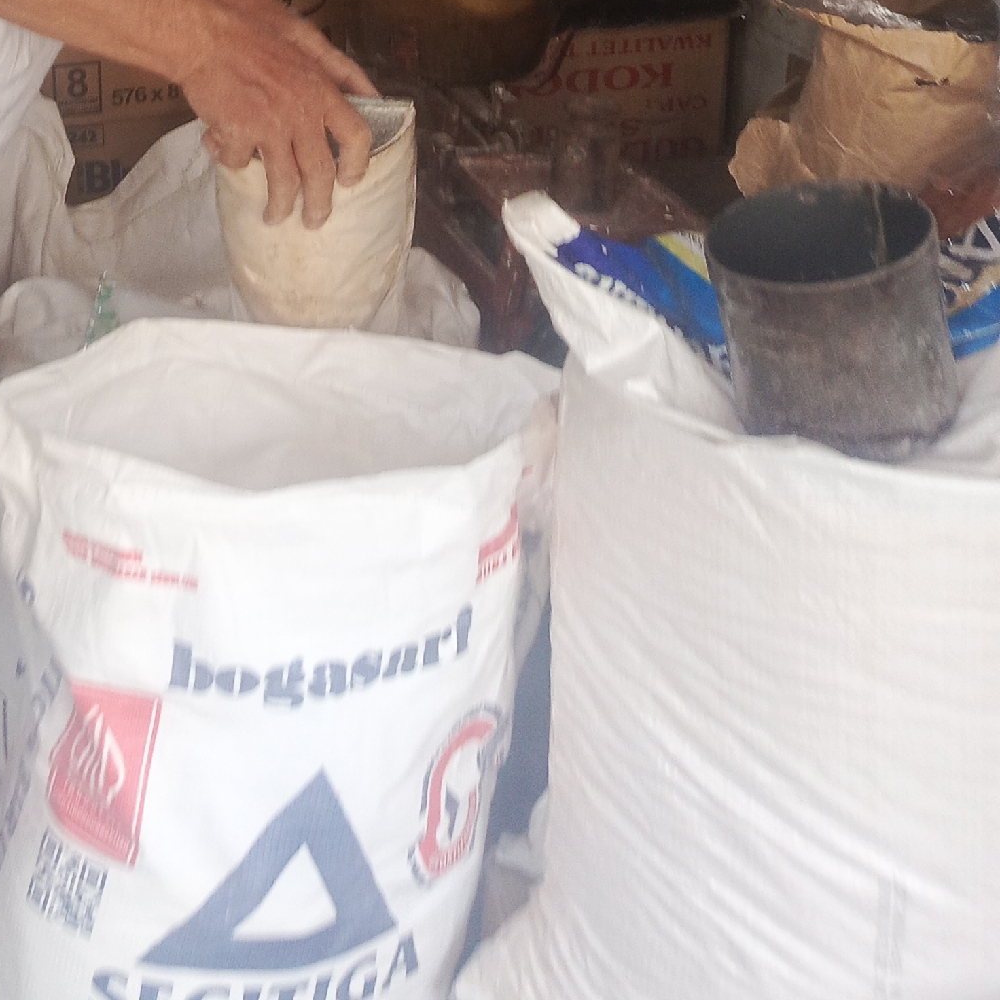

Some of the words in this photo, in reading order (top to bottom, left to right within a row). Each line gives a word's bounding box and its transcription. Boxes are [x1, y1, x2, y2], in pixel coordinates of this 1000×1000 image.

[67, 68, 89, 99] 8
[111, 86, 147, 106] 576
[504, 61, 674, 98] KODO
[169, 602, 473, 707] bogasari
